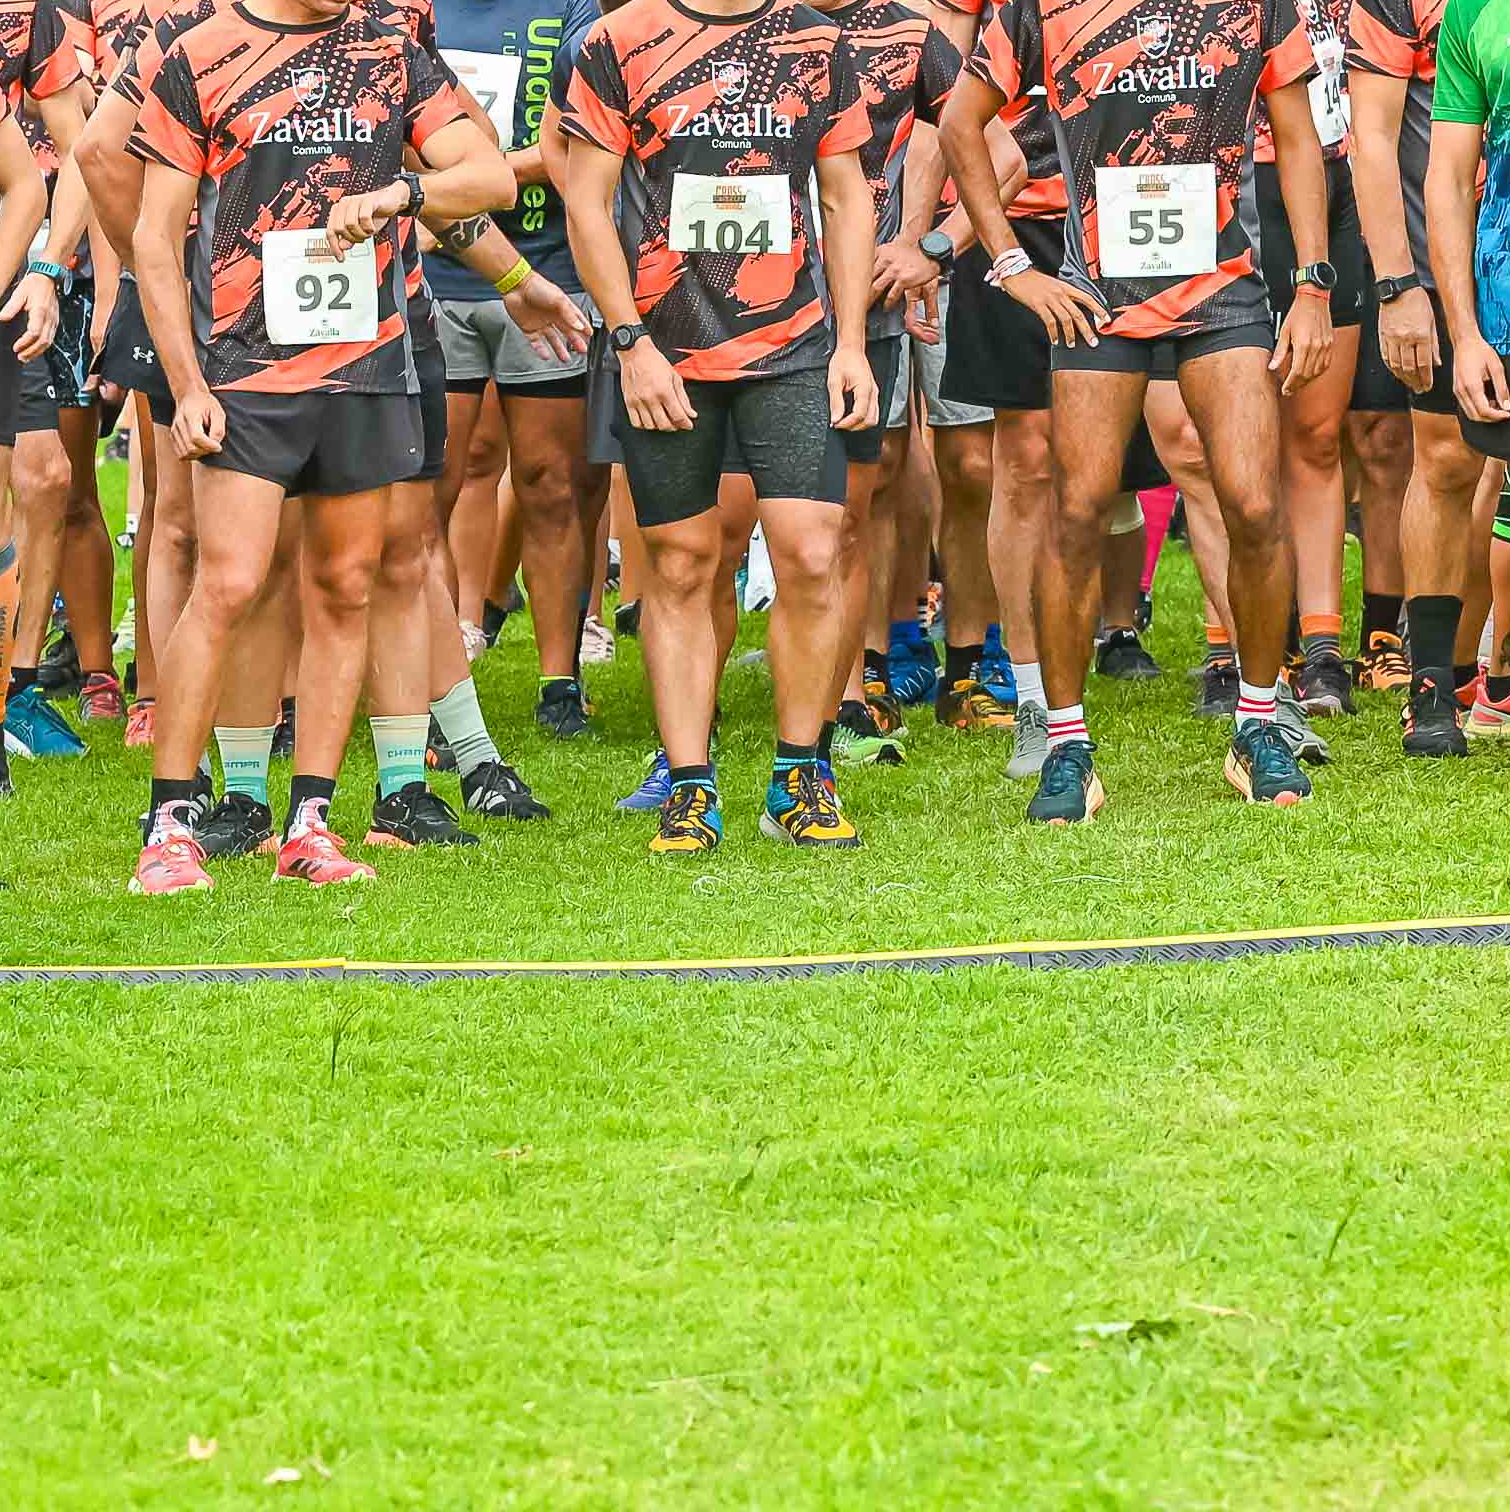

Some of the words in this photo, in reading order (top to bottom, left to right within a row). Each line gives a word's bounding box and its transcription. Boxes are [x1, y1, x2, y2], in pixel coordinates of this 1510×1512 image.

[1093, 55, 1217, 96] Zavalla
[1137, 93, 1177, 104] Comuna
[248, 107, 374, 145] Zavalla
[666, 102, 793, 139] Zavalla
[292, 144, 333, 156] Comuna
[711, 138, 752, 149] Comuna
[687, 220, 774, 254] 104
[1129, 208, 1184, 246] 55
[1140, 259, 1172, 271] Zavalla
[295, 274, 352, 312] 92
[309, 327, 340, 337] Zavalla
